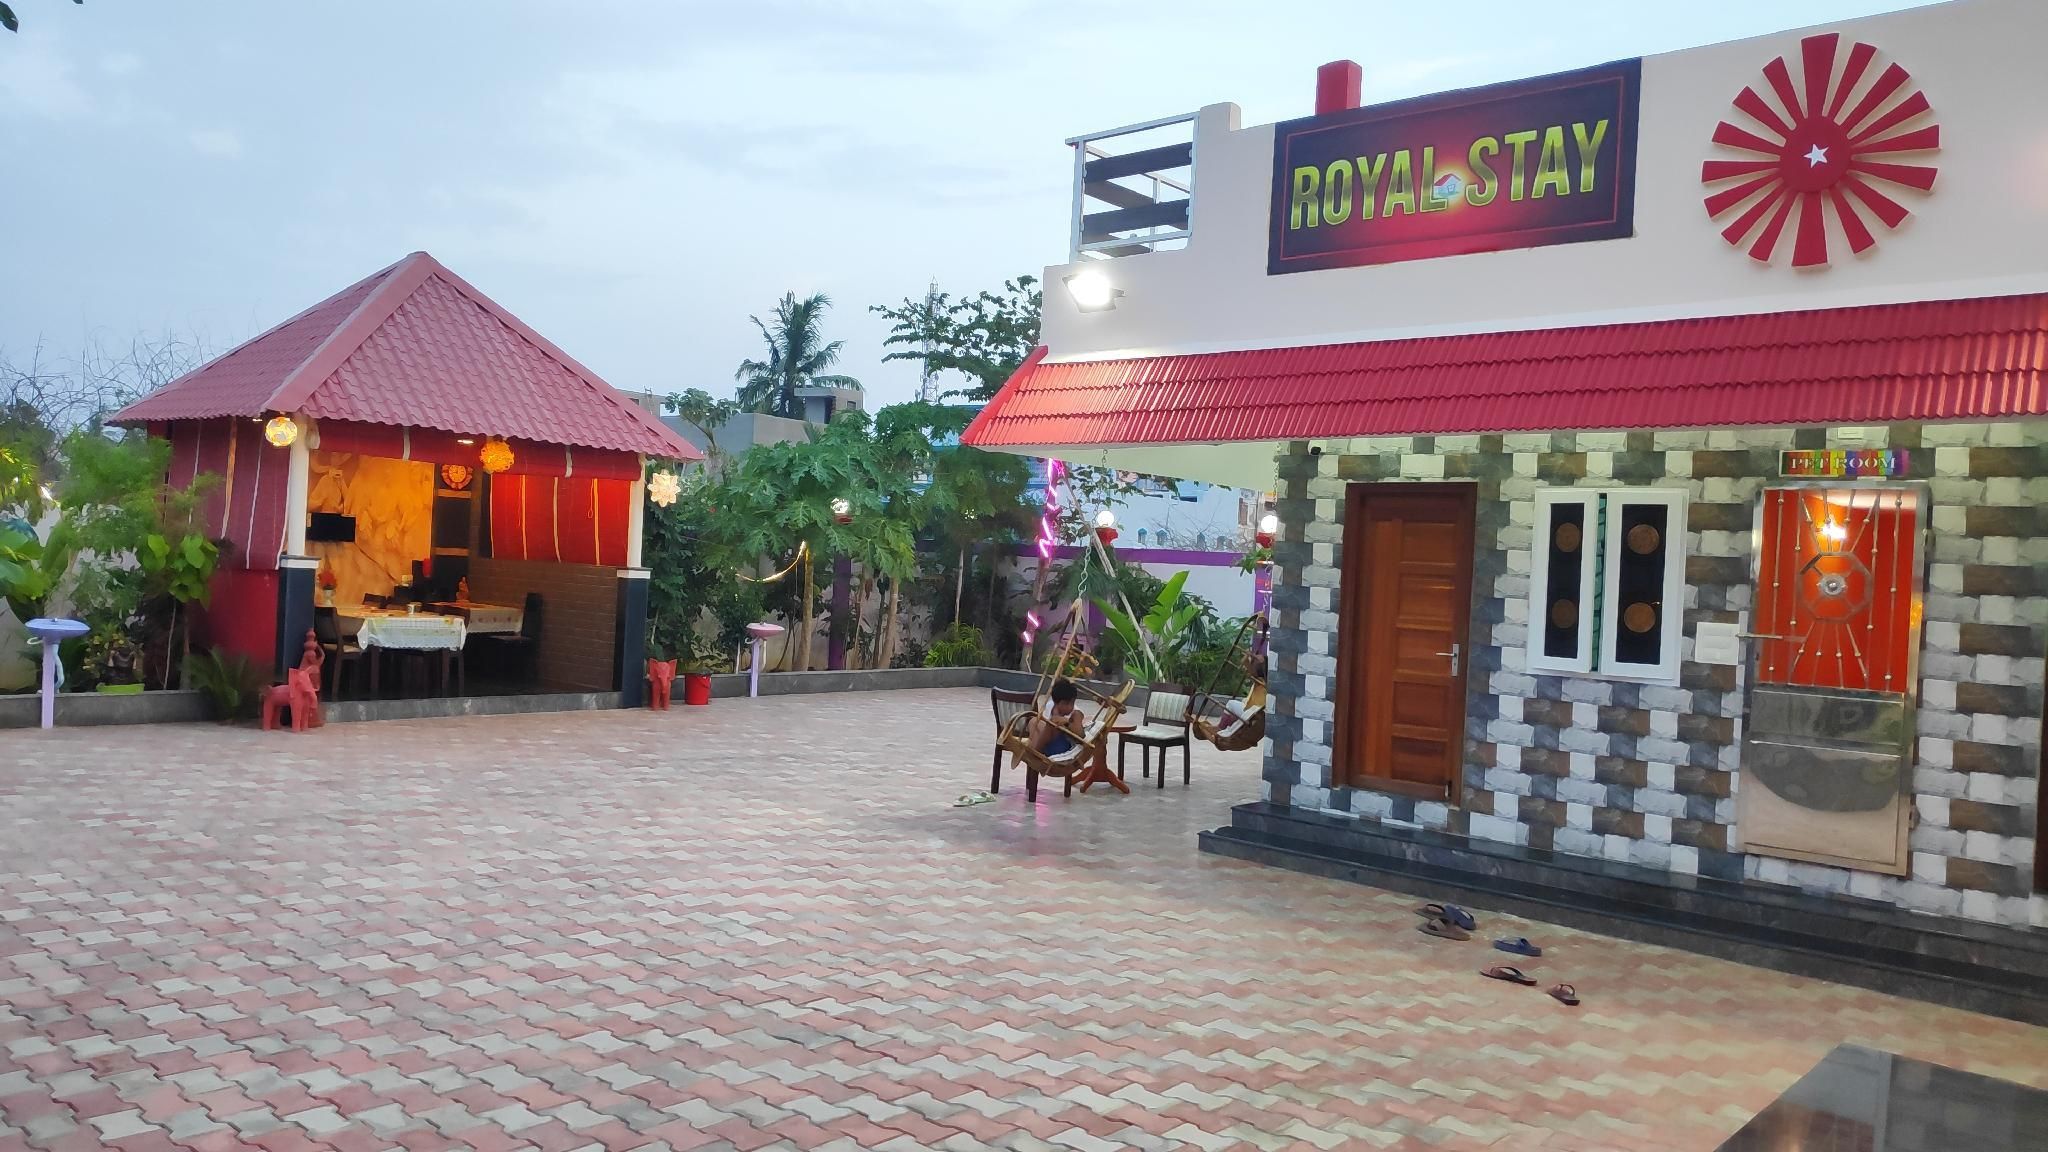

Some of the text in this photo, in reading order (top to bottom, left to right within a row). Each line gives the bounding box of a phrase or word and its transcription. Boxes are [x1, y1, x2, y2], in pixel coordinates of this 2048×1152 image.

[1290, 119, 1609, 230] ROYAL STAY
[1791, 457, 1896, 469] PET ROOM
